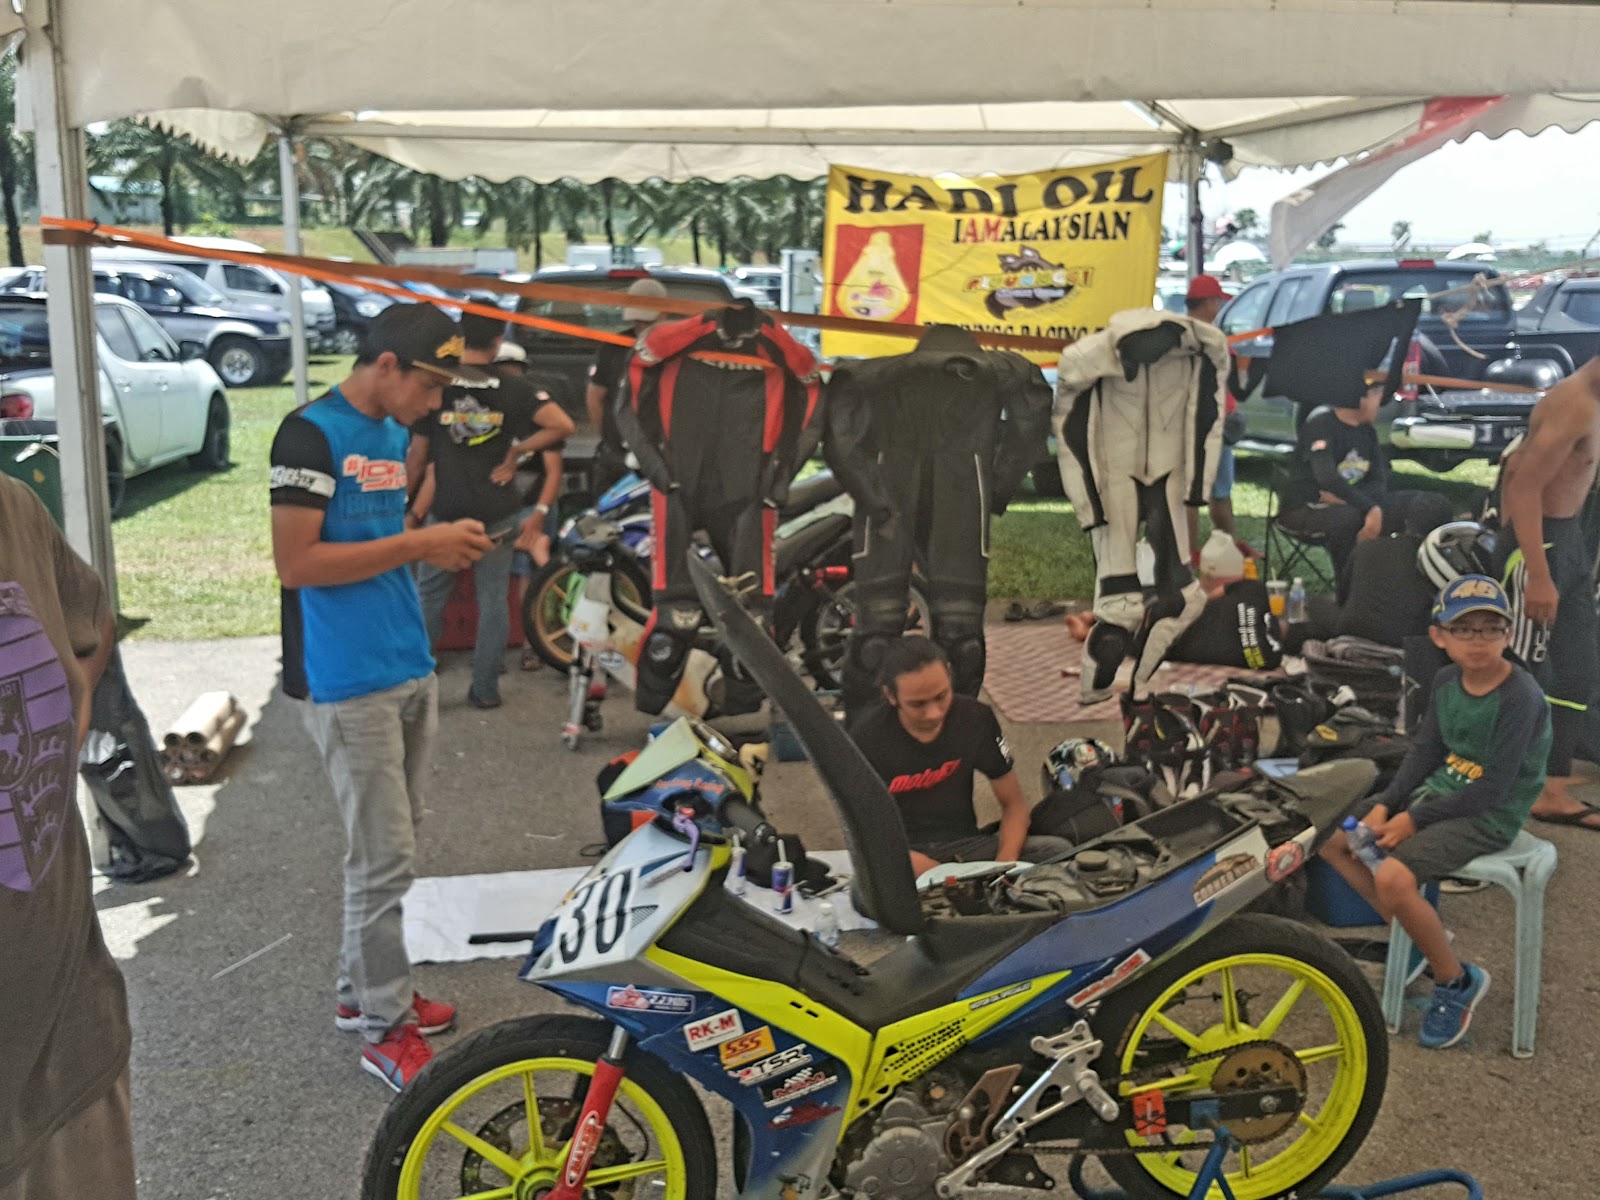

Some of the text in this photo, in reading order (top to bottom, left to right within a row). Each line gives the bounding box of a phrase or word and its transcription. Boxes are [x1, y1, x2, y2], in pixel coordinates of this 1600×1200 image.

[842, 166, 1154, 217] HADI OIL
[561, 869, 632, 964] 30
[689, 1014, 736, 1041] RK-M
